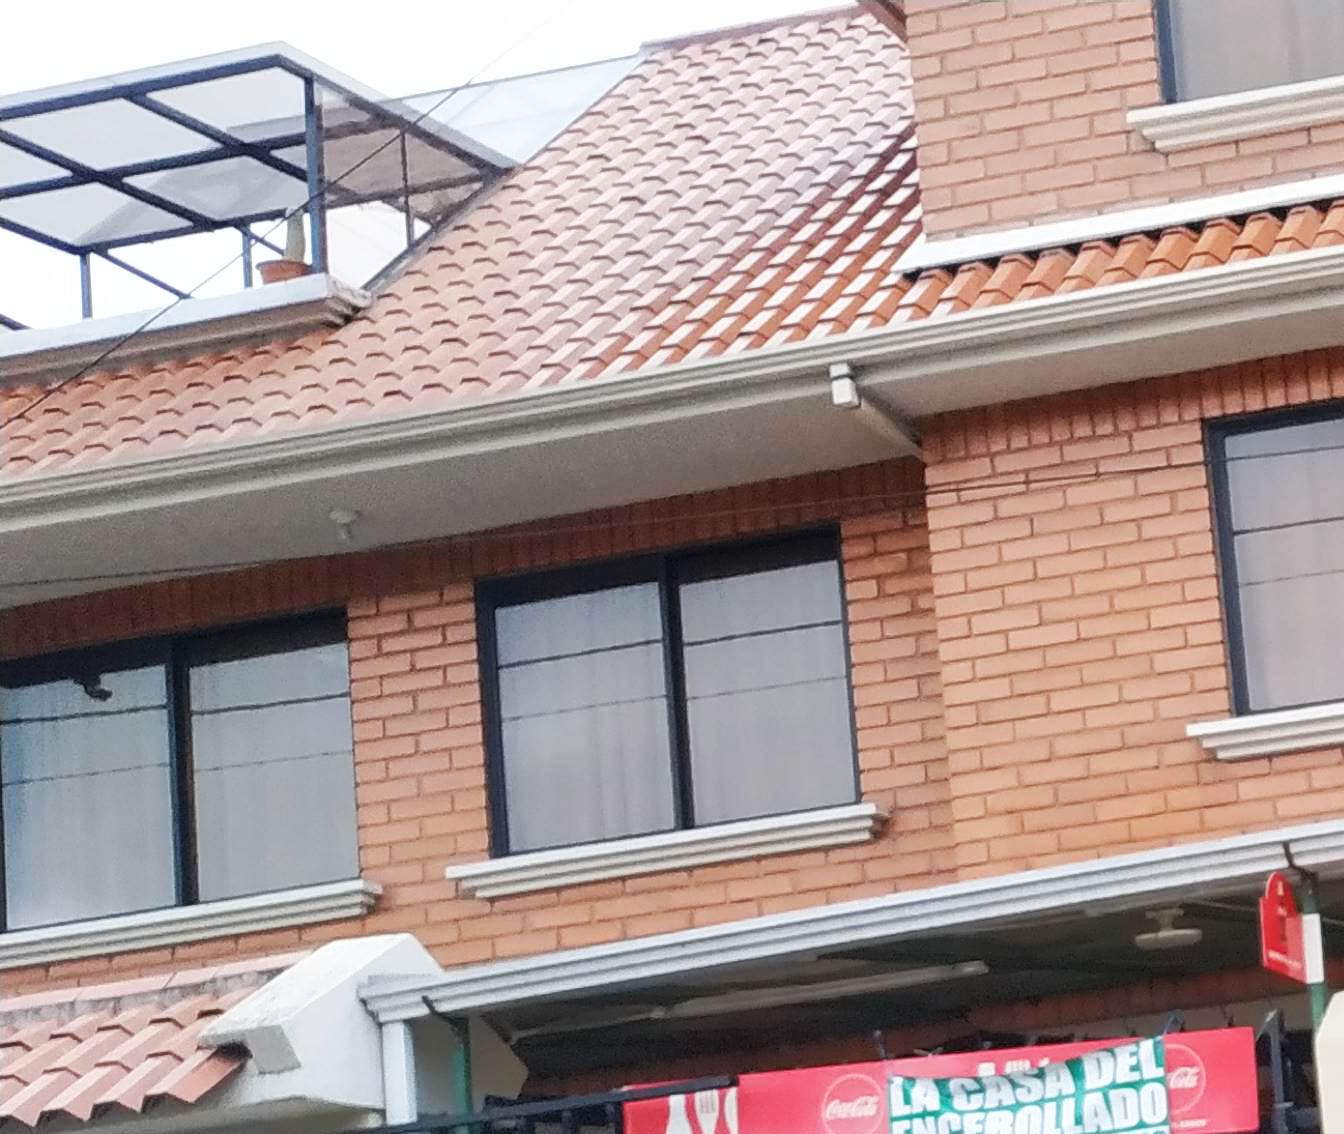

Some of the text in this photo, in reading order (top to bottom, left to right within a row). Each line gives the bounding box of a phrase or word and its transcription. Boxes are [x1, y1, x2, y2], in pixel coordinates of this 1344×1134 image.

[890, 1076, 941, 1116] LA
[949, 1061, 1075, 1112] CASA
[1082, 1038, 1165, 1091] DEL
